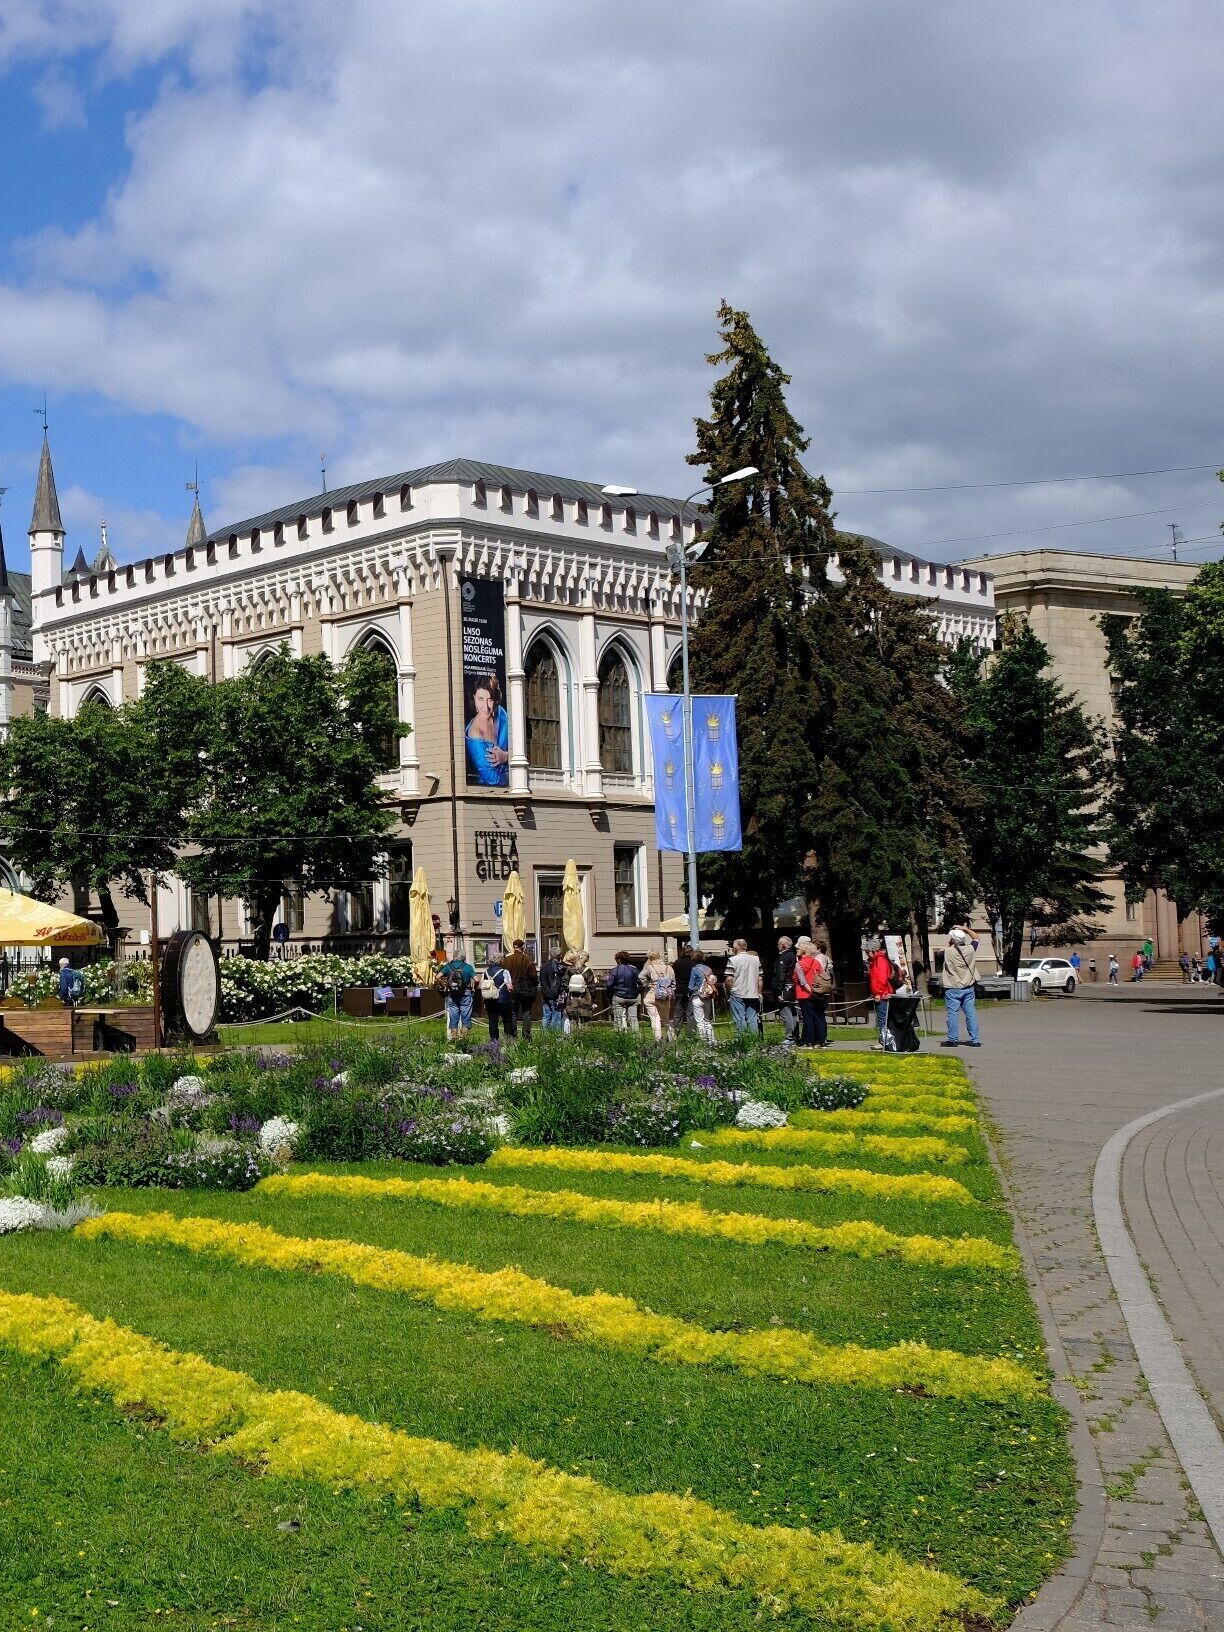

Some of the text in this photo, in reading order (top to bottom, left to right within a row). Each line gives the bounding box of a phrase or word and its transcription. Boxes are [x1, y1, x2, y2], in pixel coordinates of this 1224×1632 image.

[463, 626, 481, 636] LNSO
[463, 635, 493, 647] SEZONAS
[463, 653, 497, 665] KONCERTS
